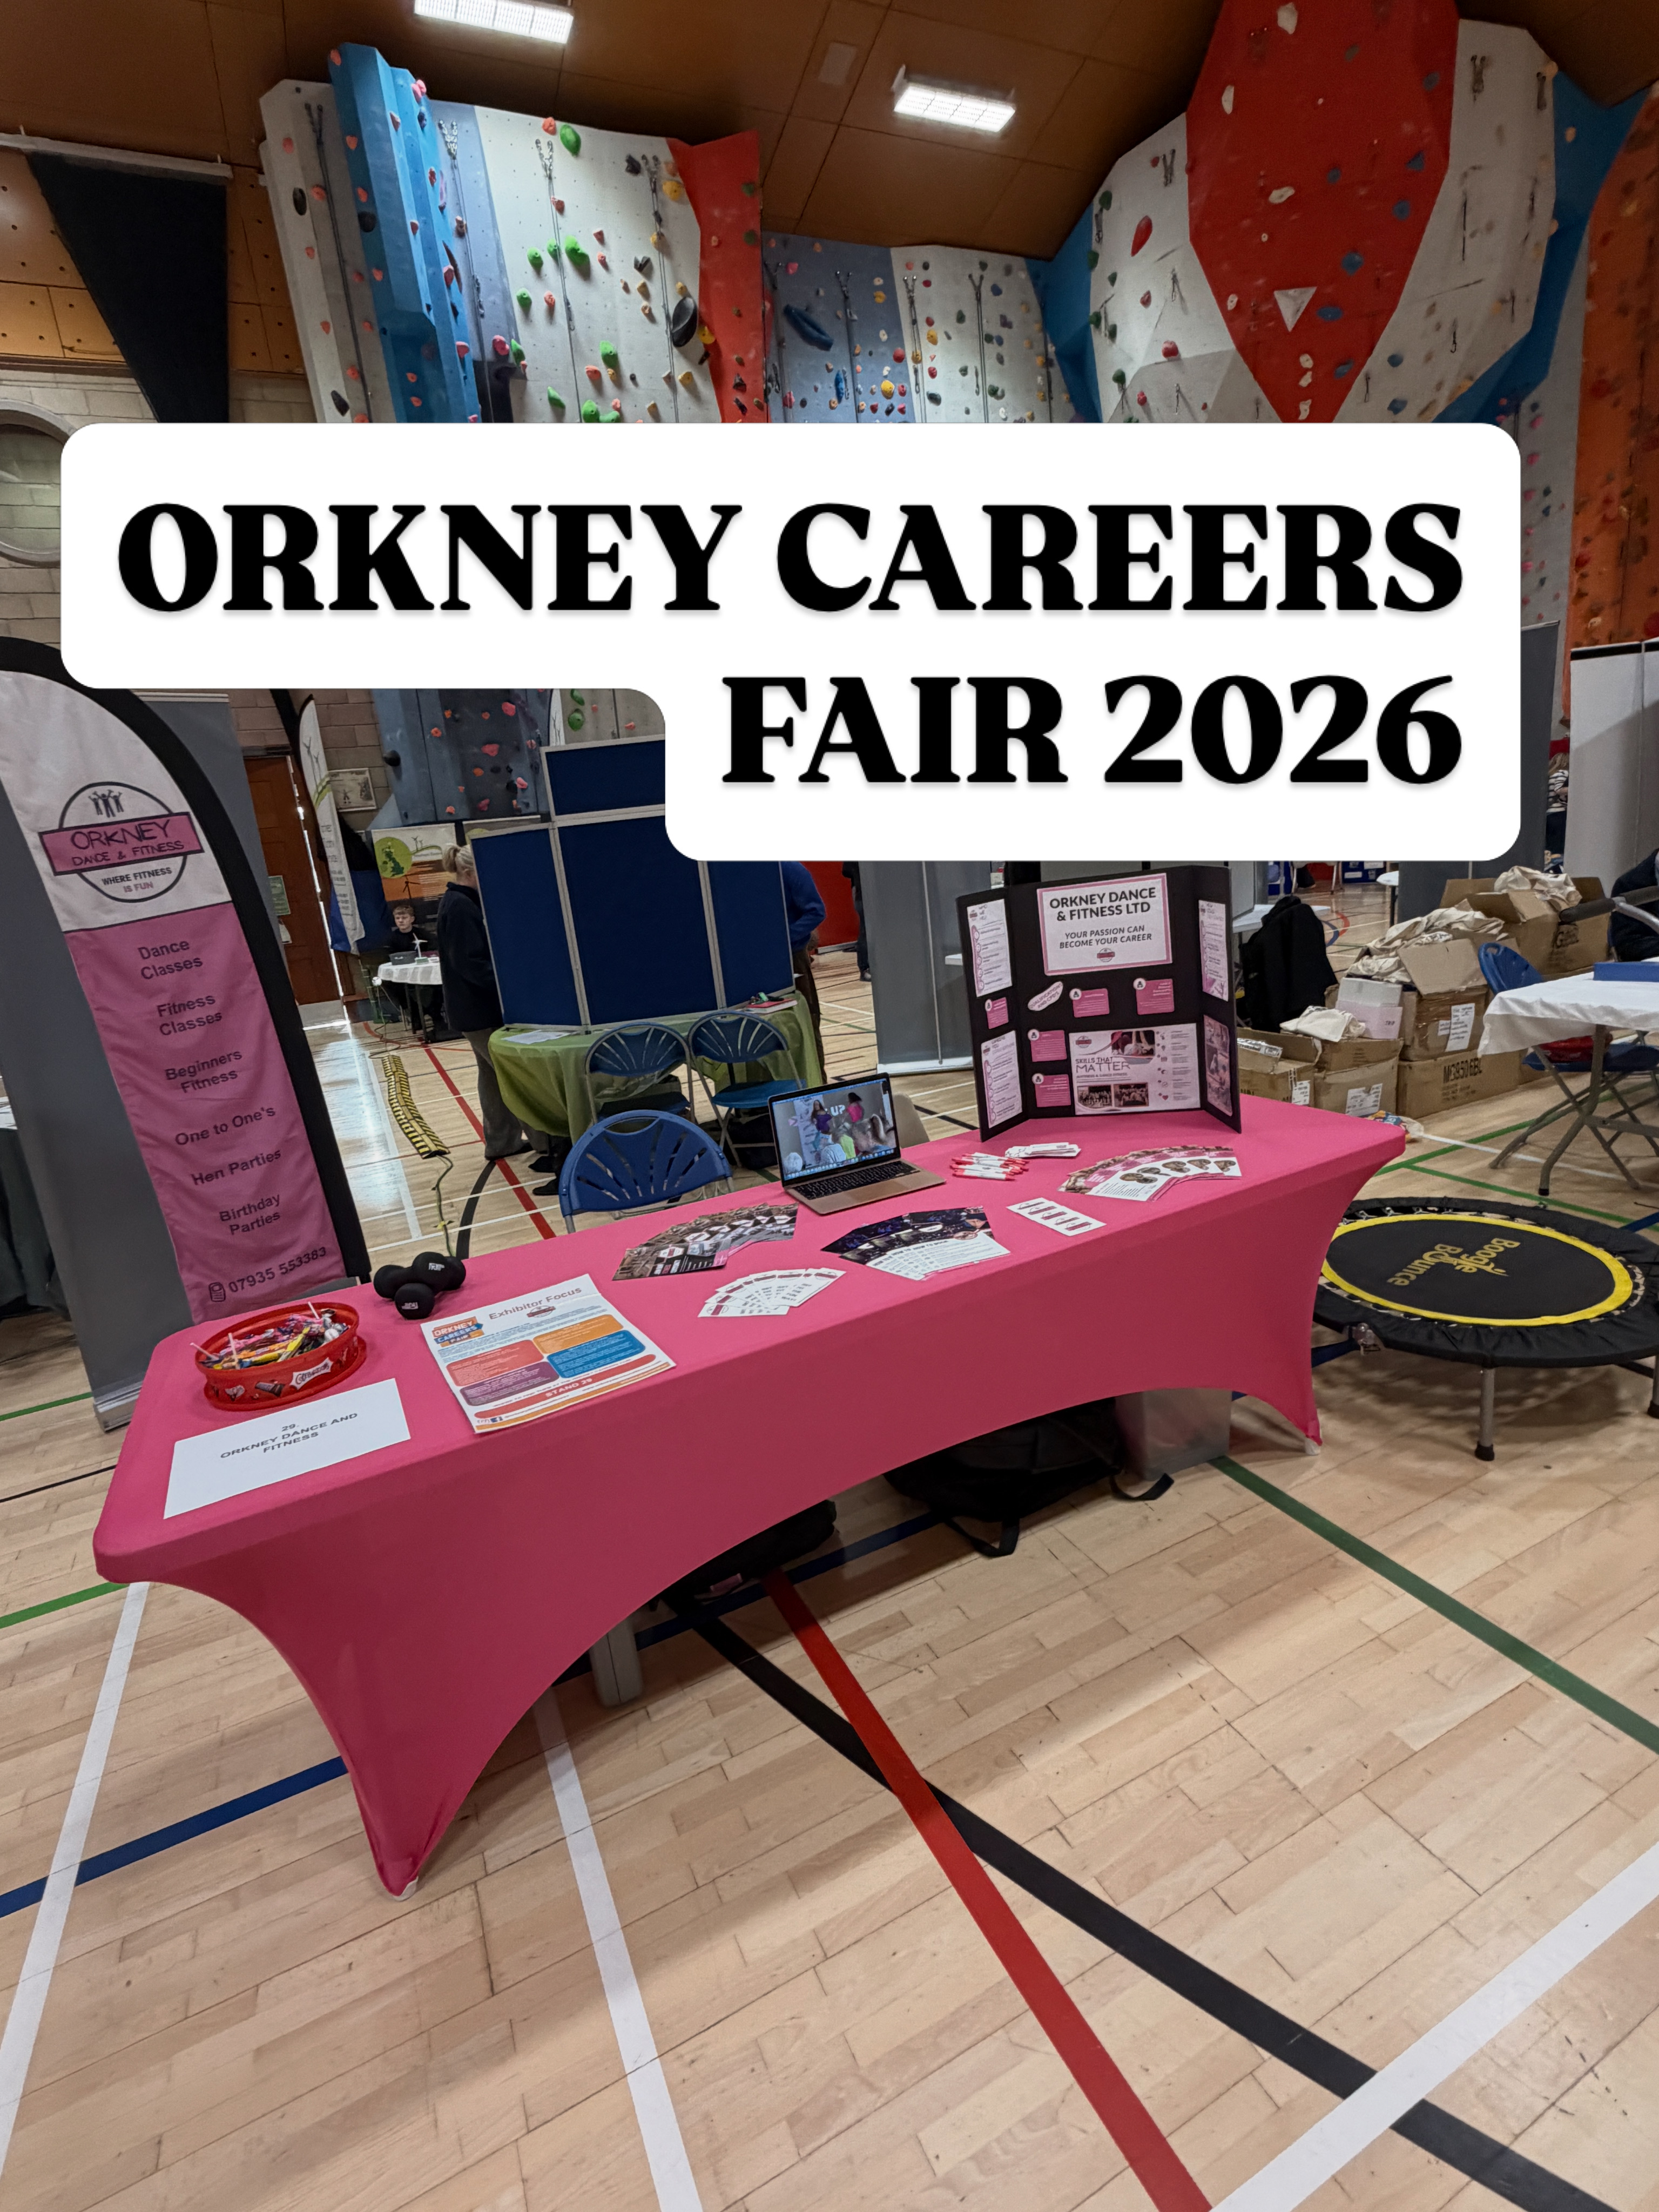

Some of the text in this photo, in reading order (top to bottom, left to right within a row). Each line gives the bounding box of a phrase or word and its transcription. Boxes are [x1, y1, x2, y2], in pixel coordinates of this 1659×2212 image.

[70, 819, 170, 850] ORKNEY
[71, 841, 184, 866] DANCE & FITNESS
[102, 867, 172, 885] WHERE FITNESS
[136, 881, 153, 891] FUN
[1050, 887, 1156, 909] ORKNEY DANCE
[1057, 901, 1150, 921] & FITNESS LTD
[1060, 933, 1152, 949] BECOME YOUR CAREER
[1065, 925, 1145, 939] YOUR PASSION CAN
[138, 941, 190, 960] Dance
[140, 957, 203, 980] Classes
[157, 995, 215, 1017] Fitness
[159, 1013, 222, 1035] Classes
[165, 1051, 242, 1080] Beginners
[1076, 1061, 1130, 1073] MATTER
[181, 1070, 238, 1094] Fitness
[175, 1107, 275, 1145] One to One's
[191, 1149, 281, 1185] Hen Parties
[219, 1194, 280, 1222] Birthday
[230, 1211, 281, 1235] Parties
[1455, 1238, 1521, 1277] Boogie
[229, 1246, 326, 1293] 07935 553383
[489, 1287, 582, 1320] Exhibitor Focus
[434, 1320, 473, 1337] ORKNEY
[437, 1325, 477, 1343] CAREERS
[545, 1382, 579, 1398] STAND
[220, 1413, 358, 1458] ORKNEY DANCE AND
[263, 1432, 319, 1453] FITNESS
